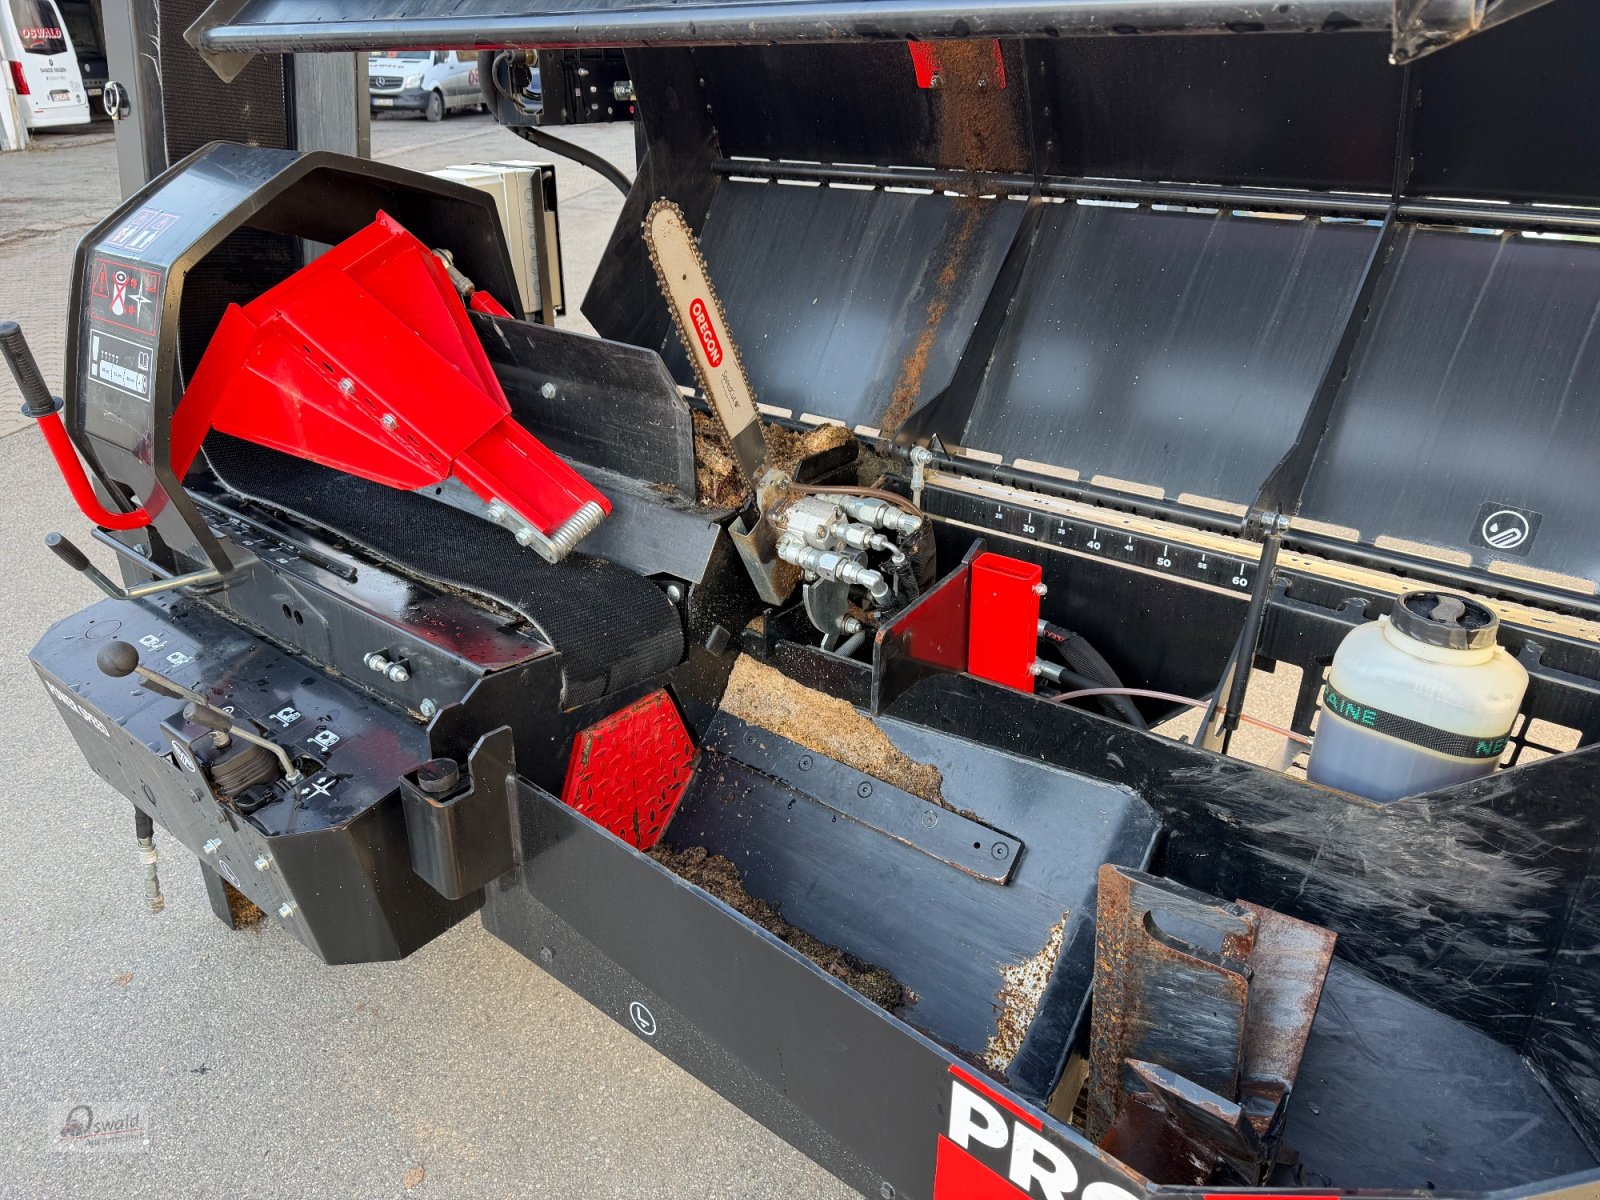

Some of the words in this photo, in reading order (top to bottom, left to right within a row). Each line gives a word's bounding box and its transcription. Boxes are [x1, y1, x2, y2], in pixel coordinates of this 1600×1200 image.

[22, 28, 61, 38] OSWALD
[692, 303, 720, 363] OREGON
[1022, 523, 1035, 534] 30
[1086, 540, 1101, 550] 40
[1124, 544, 1134, 552] 45
[1156, 557, 1171, 568] 50
[1197, 562, 1207, 570] 55
[1231, 576, 1248, 587] 60
